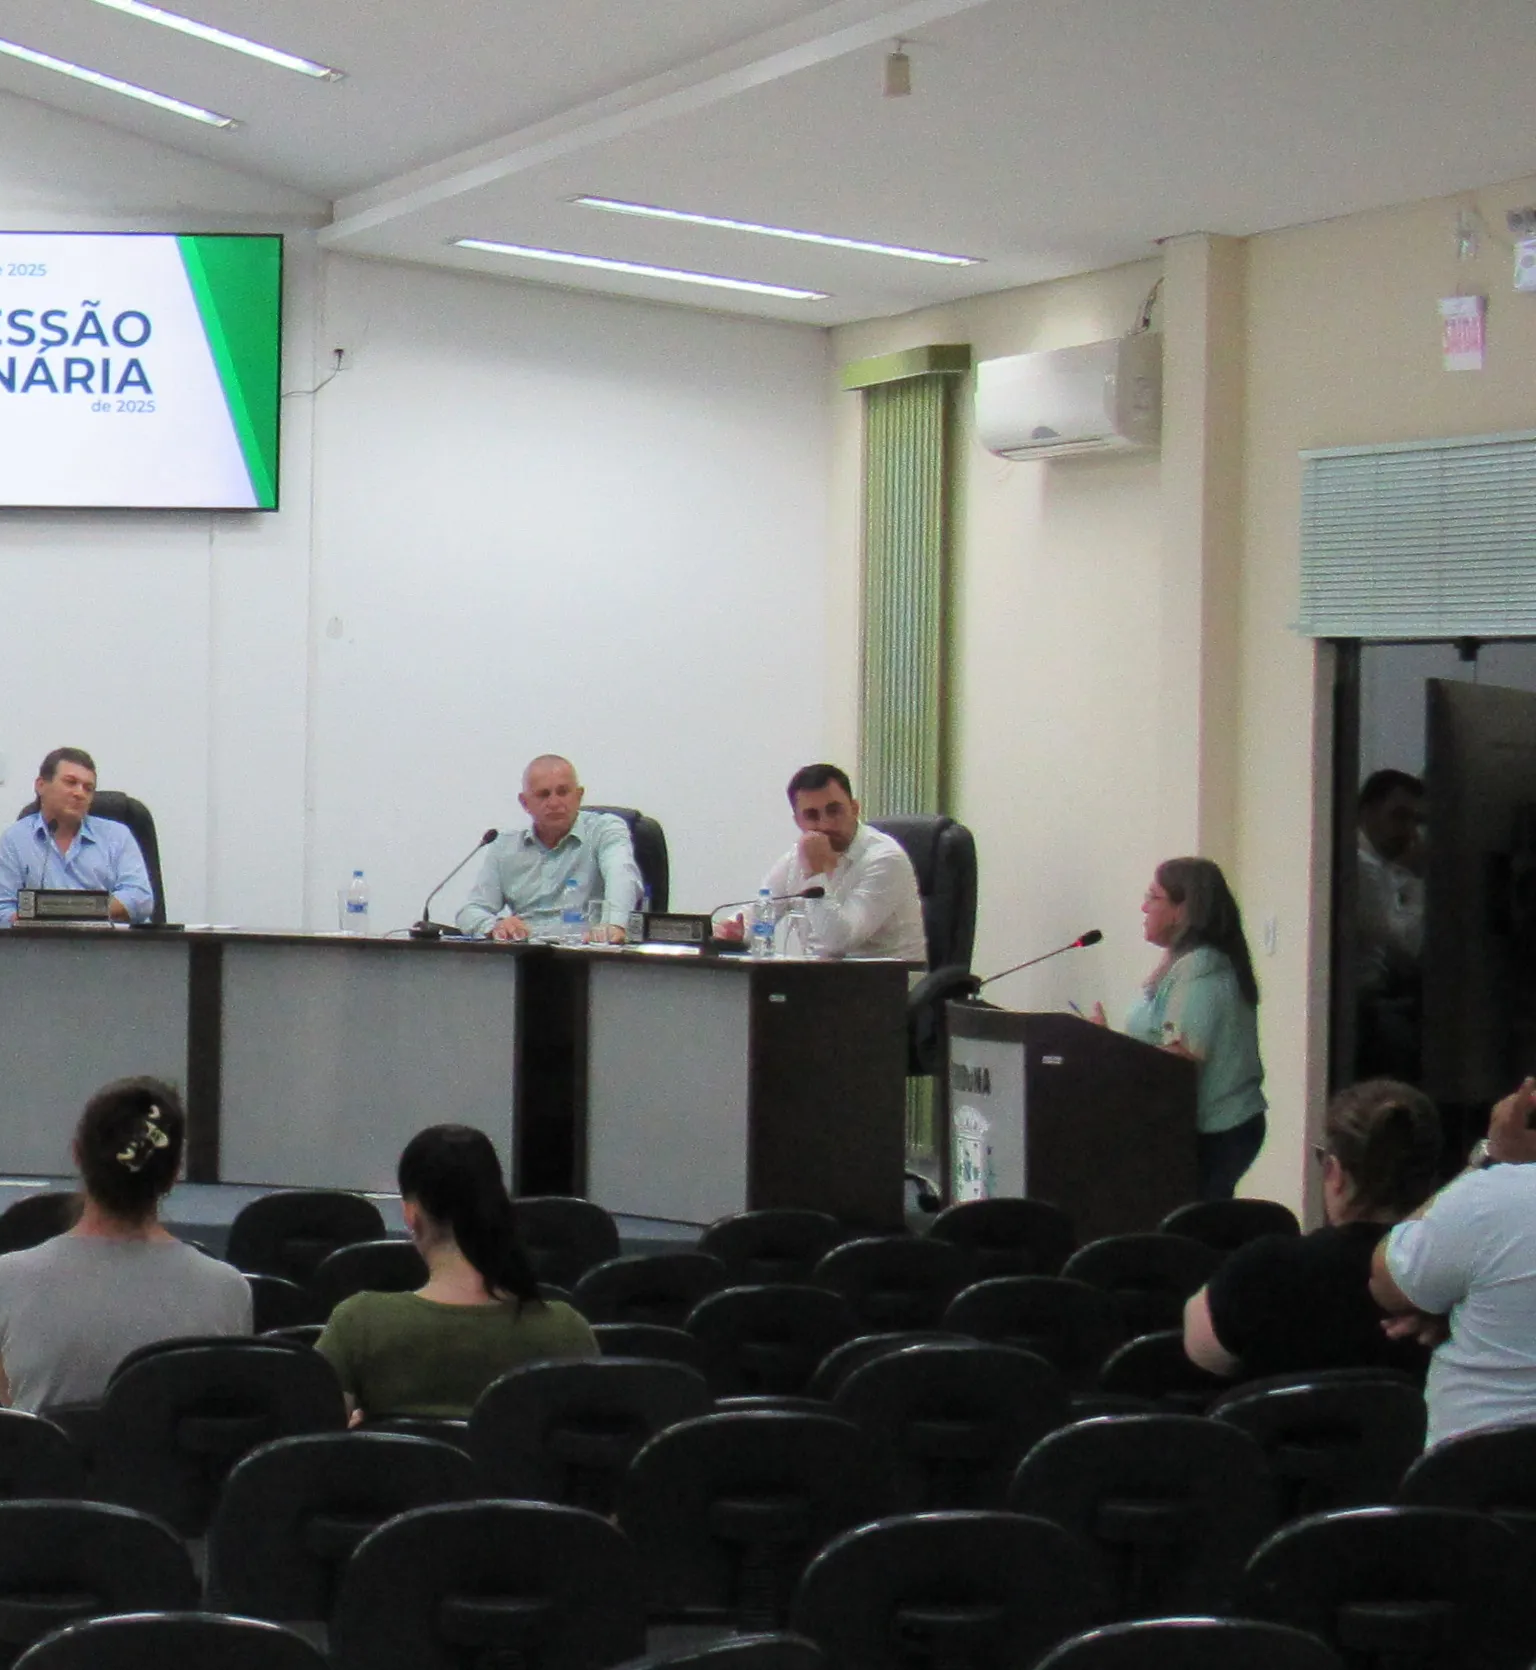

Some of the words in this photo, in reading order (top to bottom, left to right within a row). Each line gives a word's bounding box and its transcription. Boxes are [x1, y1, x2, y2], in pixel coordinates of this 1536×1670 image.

[7, 263, 47, 277] 2025
[90, 399, 111, 413] de
[116, 400, 156, 413] 2025
